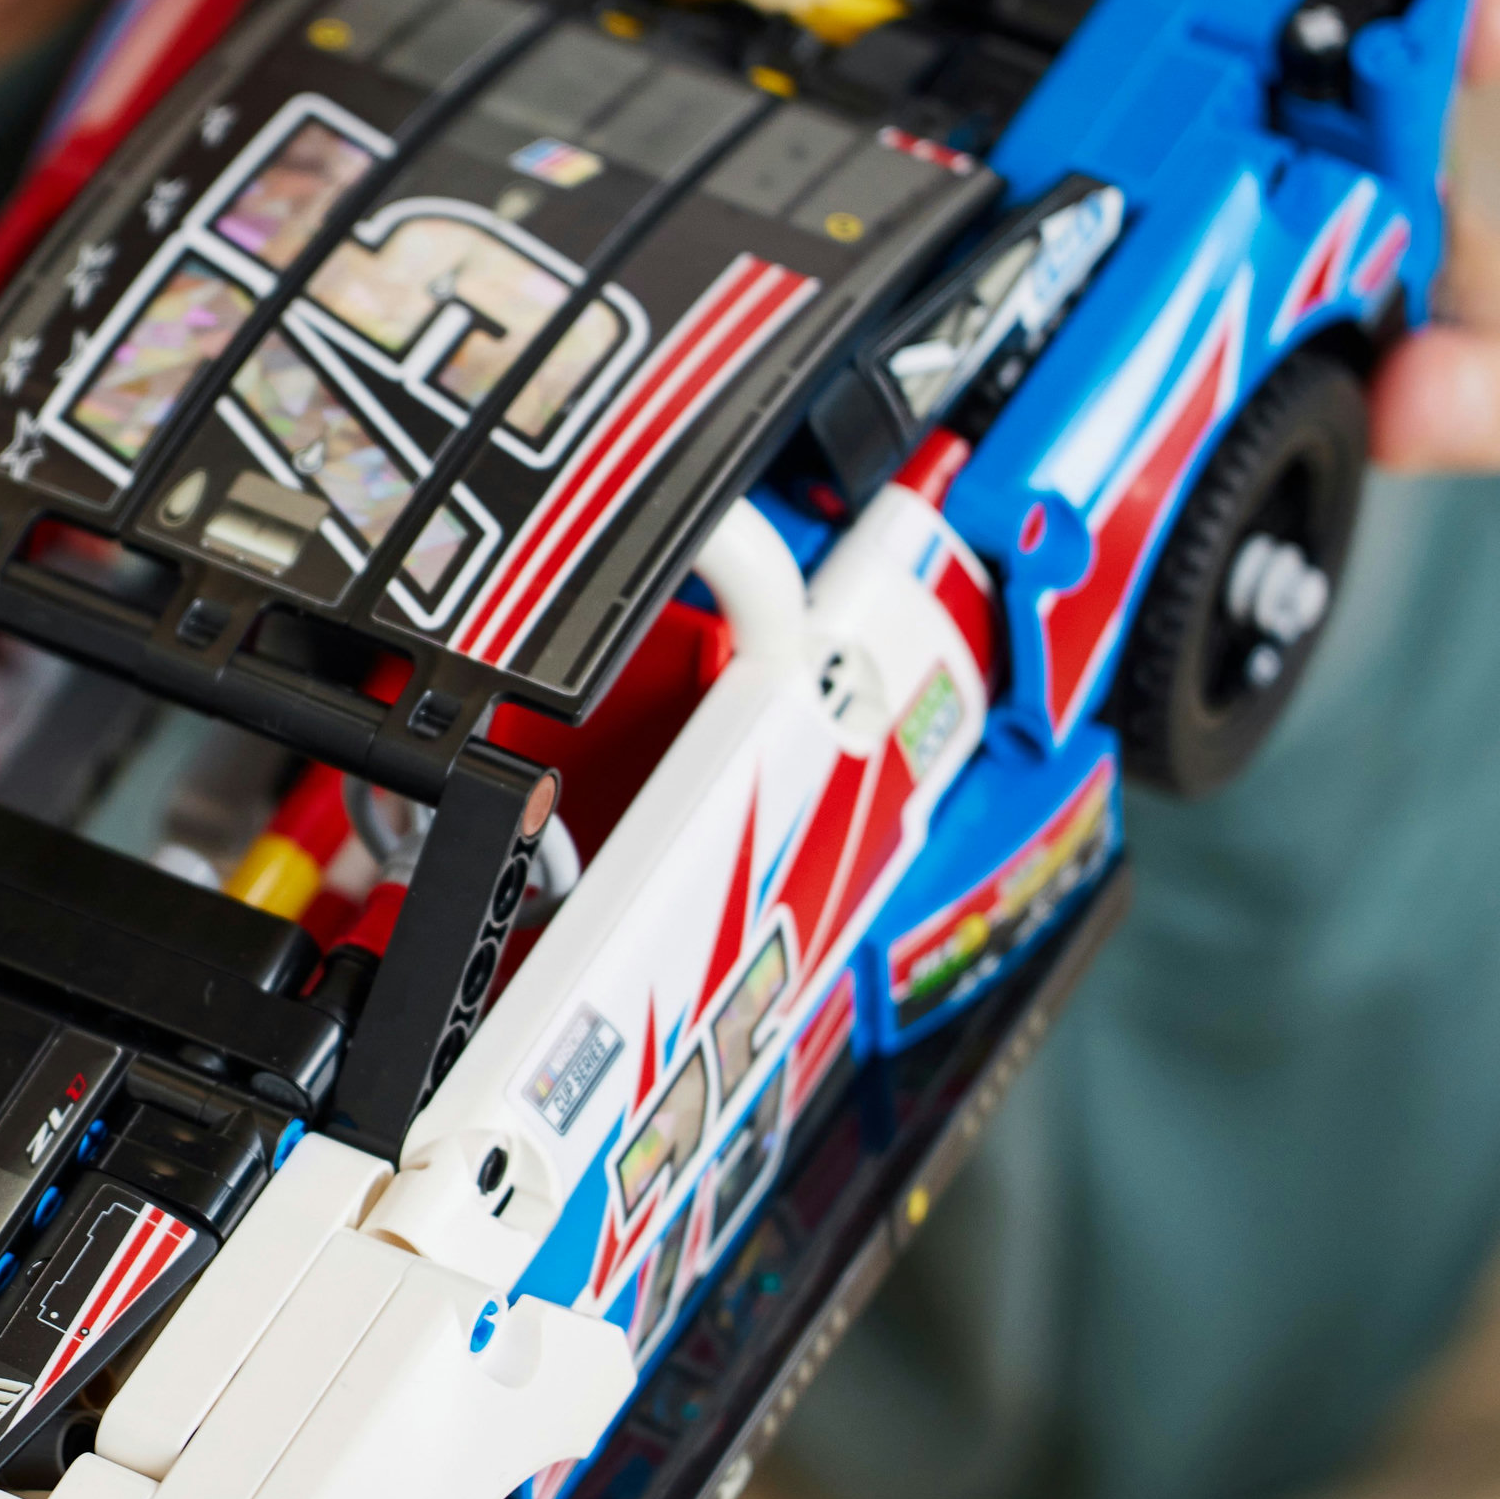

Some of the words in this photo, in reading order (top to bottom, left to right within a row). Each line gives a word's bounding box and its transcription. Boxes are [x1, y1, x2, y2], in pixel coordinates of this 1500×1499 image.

[40, 91, 651, 632] 75
[553, 1079, 576, 1113] CUP
[571, 1036, 606, 1086] SERIES
